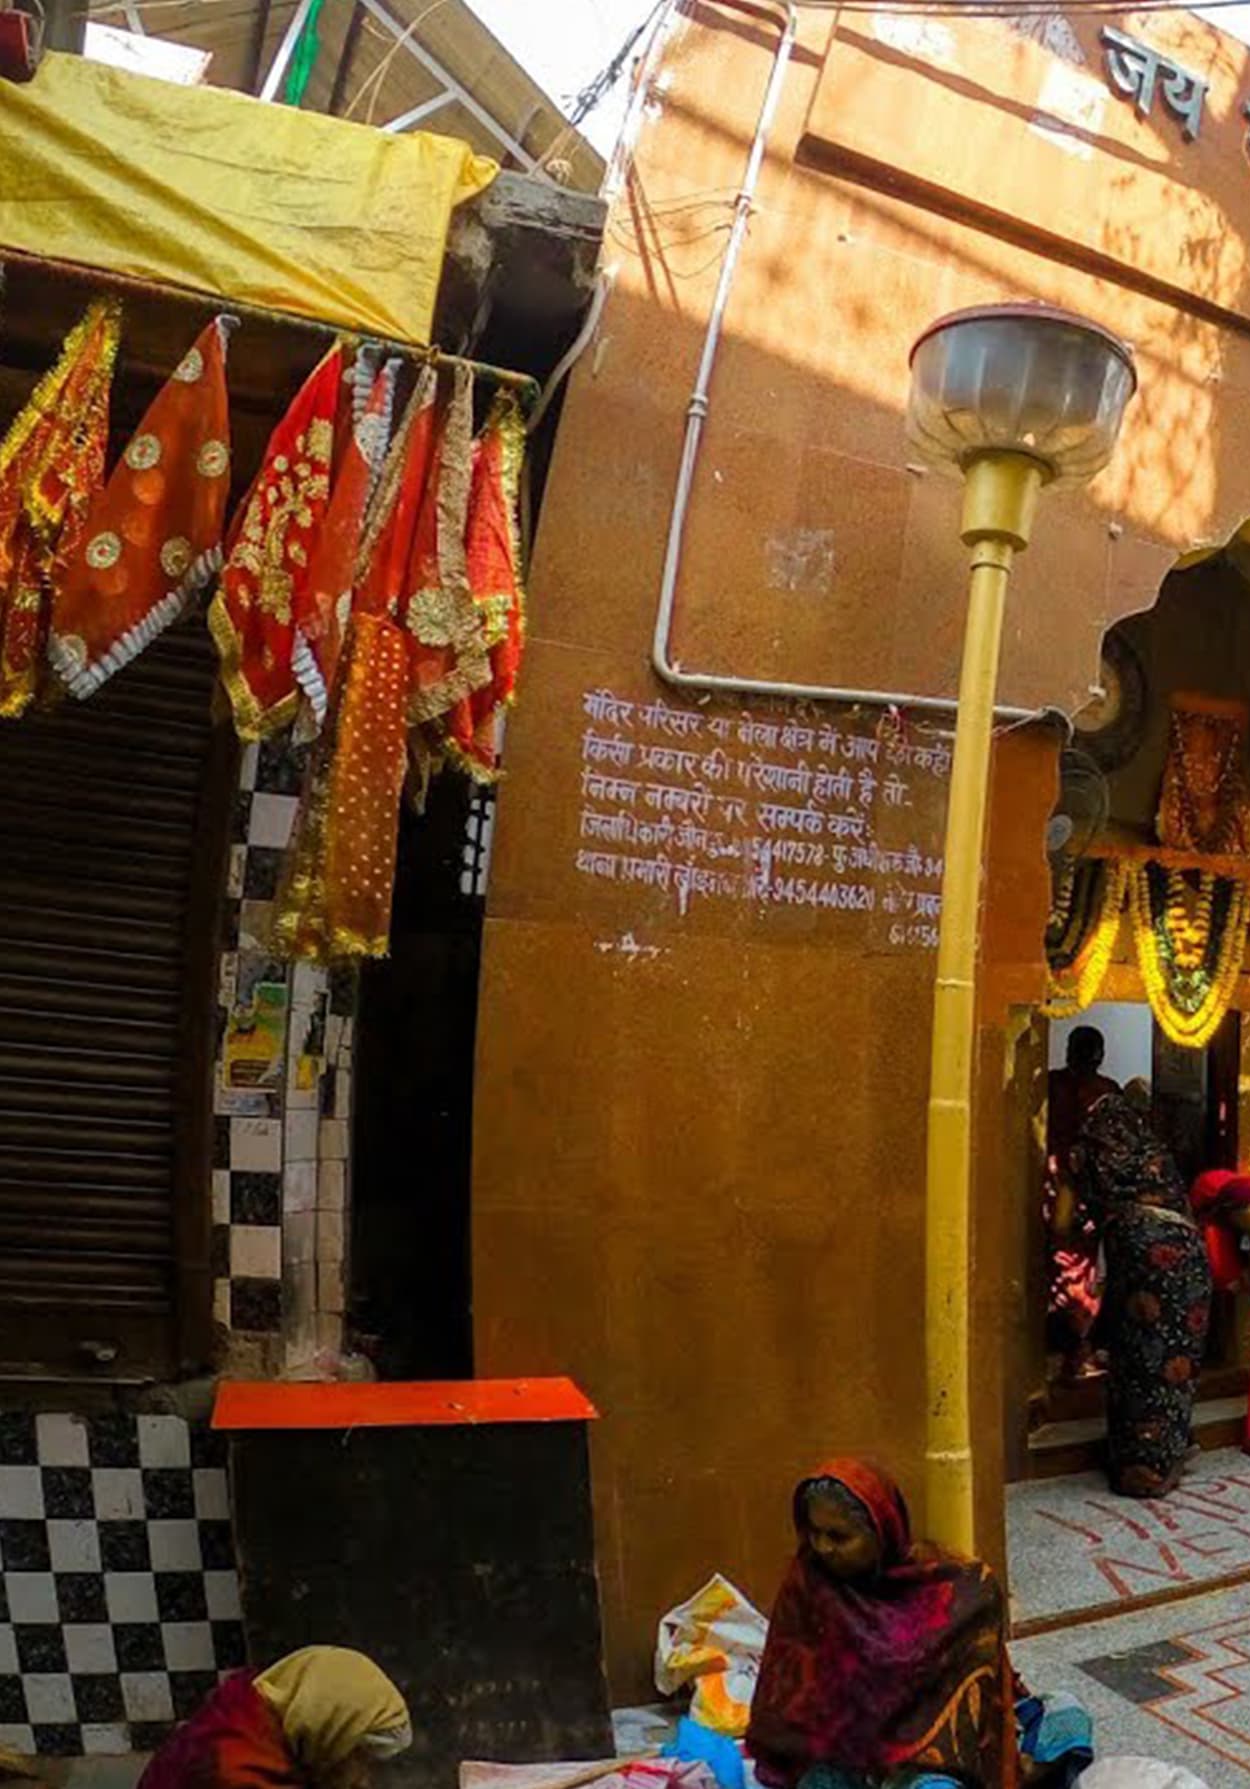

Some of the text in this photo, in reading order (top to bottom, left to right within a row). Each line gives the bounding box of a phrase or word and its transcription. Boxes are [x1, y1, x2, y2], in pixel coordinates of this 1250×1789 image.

[1099, 25, 1209, 143] जय
[583, 688, 634, 728] मंदिर
[638, 698, 704, 738] परिसर
[707, 715, 733, 739] या
[840, 735, 880, 763] आप
[581, 728, 635, 767] किसी
[636, 744, 701, 779] प्रकार
[701, 747, 735, 781] की
[737, 751, 812, 796] परेशानी
[812, 763, 854, 806] होती
[858, 767, 878, 808] है
[717, 795, 749, 827] पर
